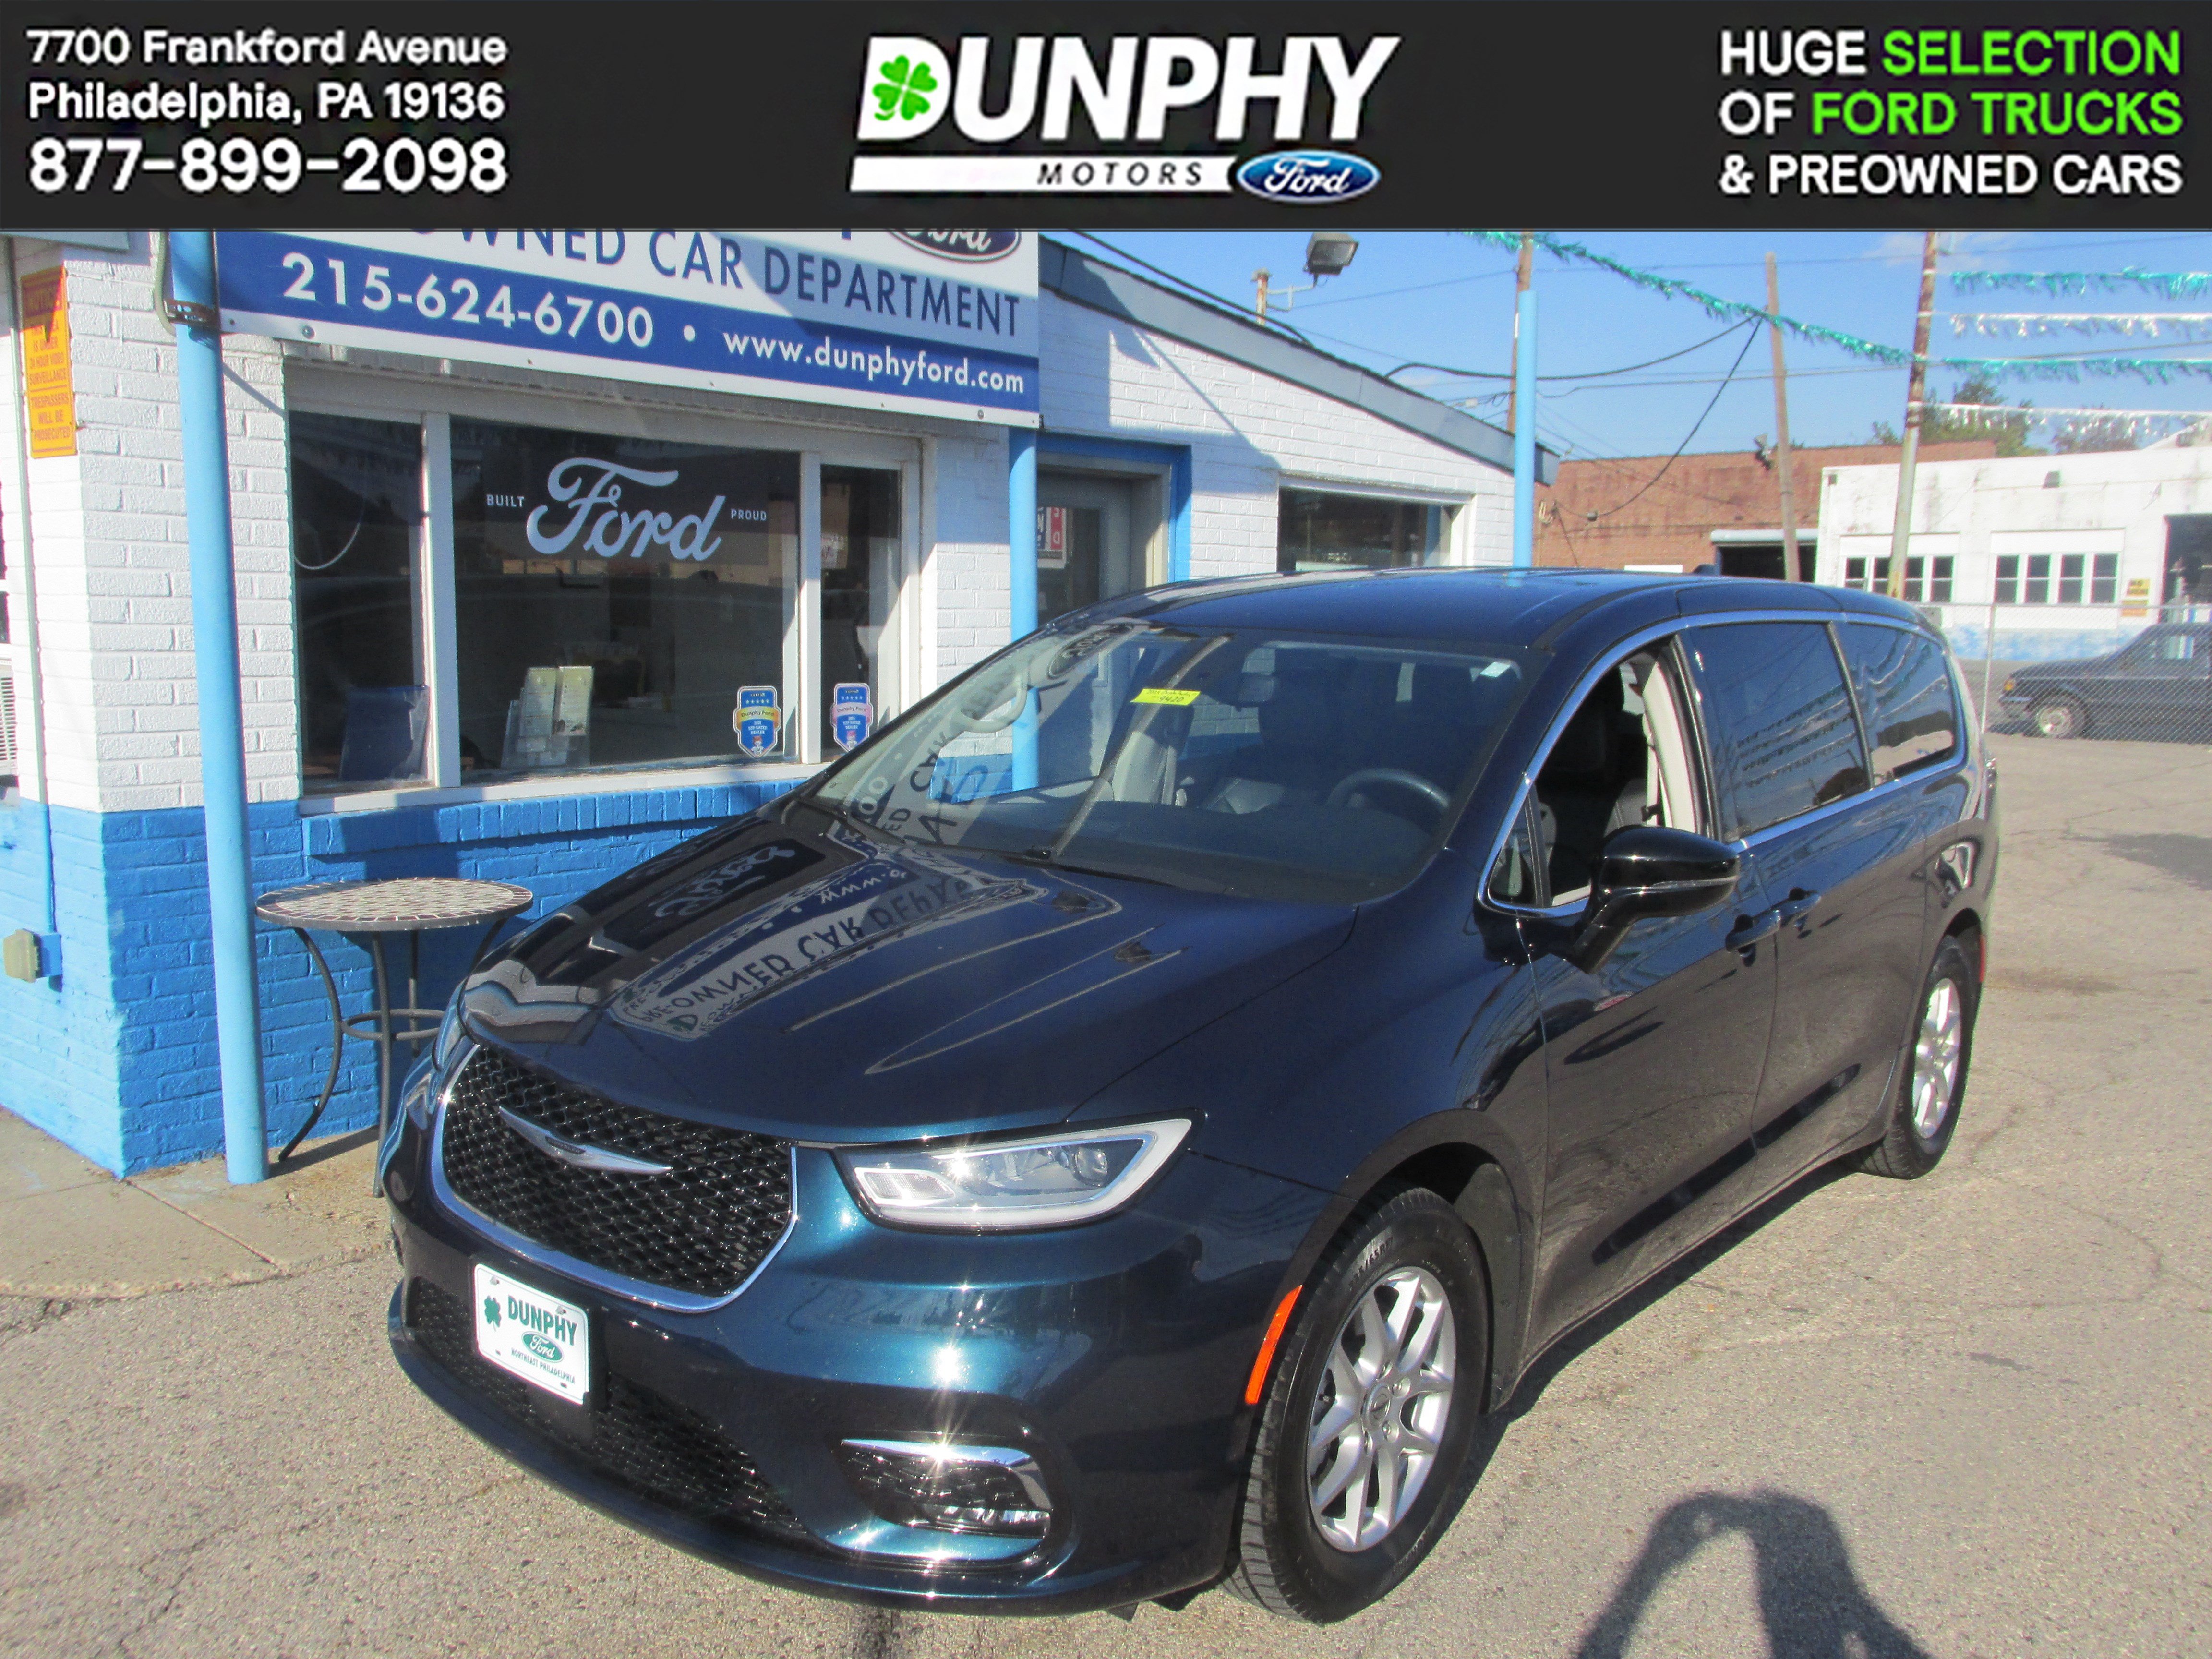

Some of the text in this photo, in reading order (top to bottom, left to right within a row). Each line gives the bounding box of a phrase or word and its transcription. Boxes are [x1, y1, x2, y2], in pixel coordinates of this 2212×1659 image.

[282, 252, 1024, 394] 215-624-6700 www.dunphyford.com
[649, 232, 744, 289] CAR
[764, 246, 1020, 337] DEPARTMENT
[487, 457, 767, 561] BUILT Ford PROUD
[508, 1295, 577, 1346] DUNPHY
[530, 1335, 555, 1358] Ford
[511, 1347, 576, 1384] NORTHEAST PHILADELPHIA
